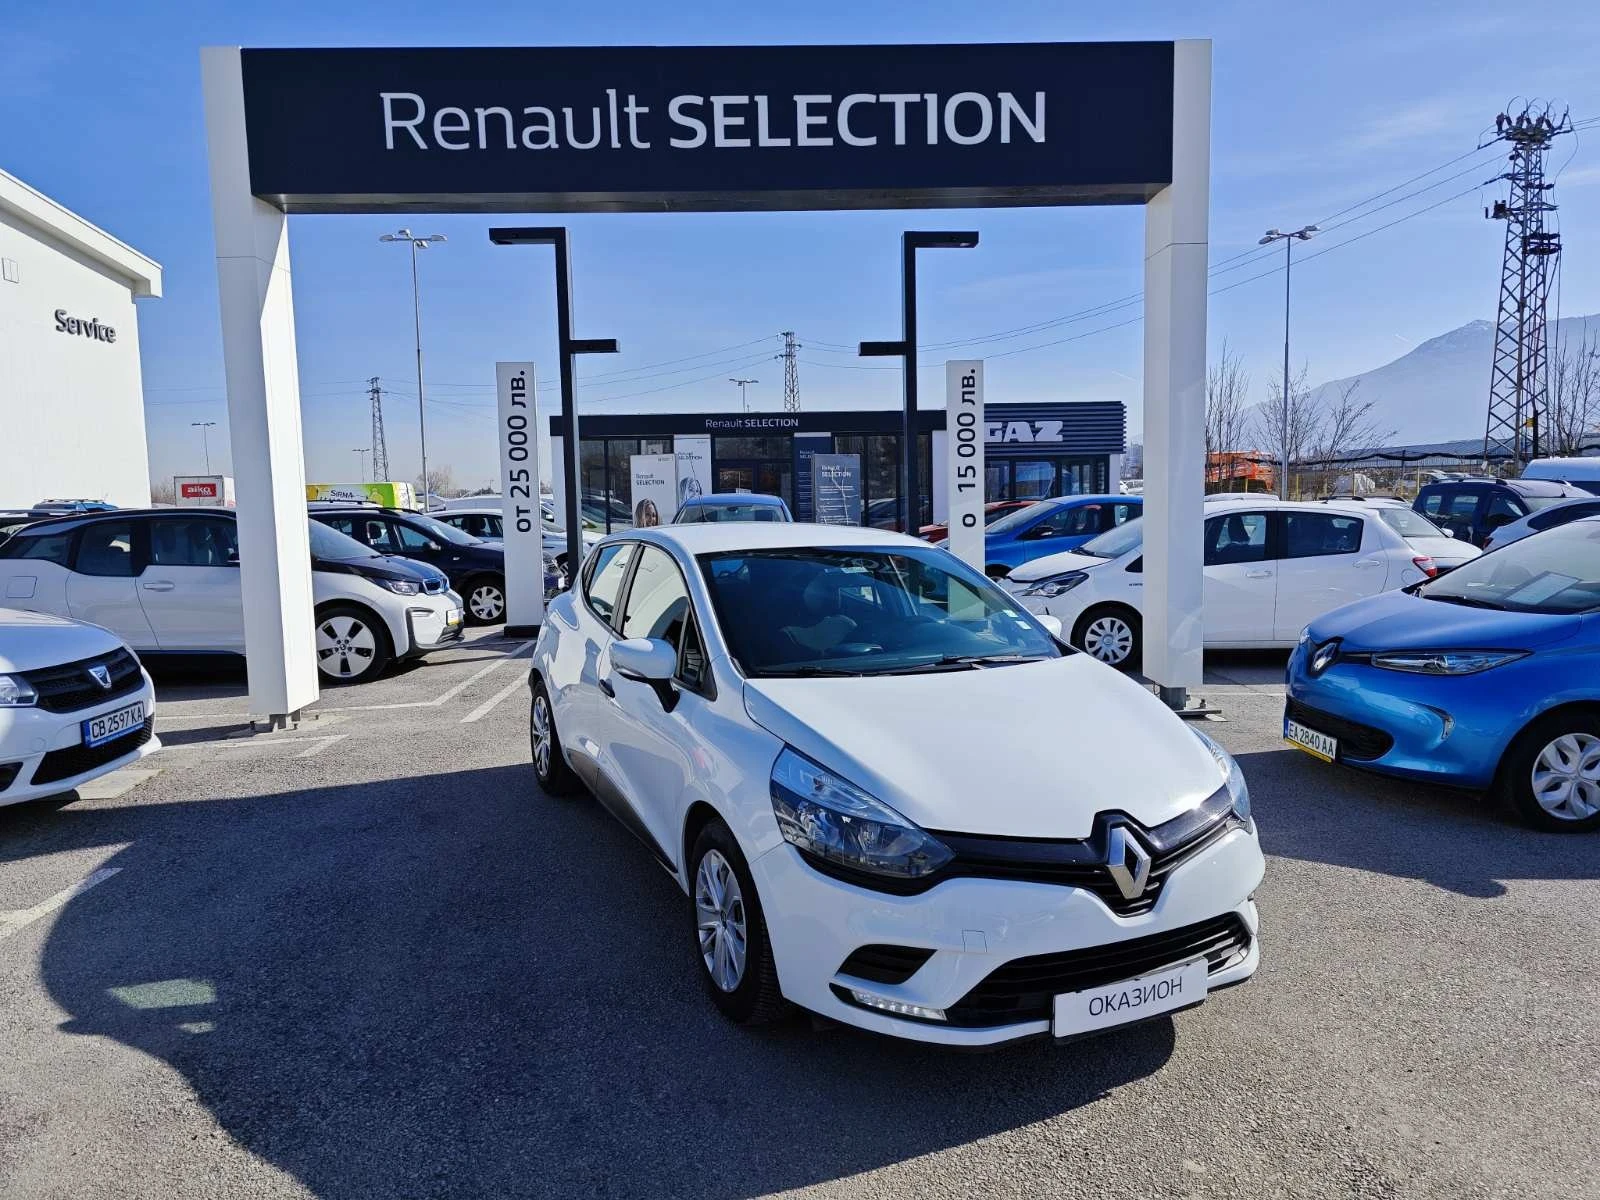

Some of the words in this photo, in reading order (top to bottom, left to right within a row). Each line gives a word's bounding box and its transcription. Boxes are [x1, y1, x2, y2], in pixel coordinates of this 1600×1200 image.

[379, 89, 651, 151] Renault
[669, 91, 1046, 150] SELECTION
[54, 308, 117, 343] Service
[511, 370, 527, 408] лв.
[961, 368, 976, 405] лв.
[507, 415, 529, 461] 000
[705, 418, 742, 428] Renault
[744, 418, 799, 428] SELECTION
[956, 412, 976, 458] 000
[509, 469, 530, 498] 25
[957, 465, 976, 493] 15
[91, 720, 106, 739] CB
[108, 711, 129, 734] 2597
[131, 706, 143, 724] KA
[1289, 722, 1299, 741] EA
[1300, 728, 1320, 749] 2840
[1322, 738, 1334, 756] AA
[1088, 976, 1183, 1016] ОКАЗИОН
